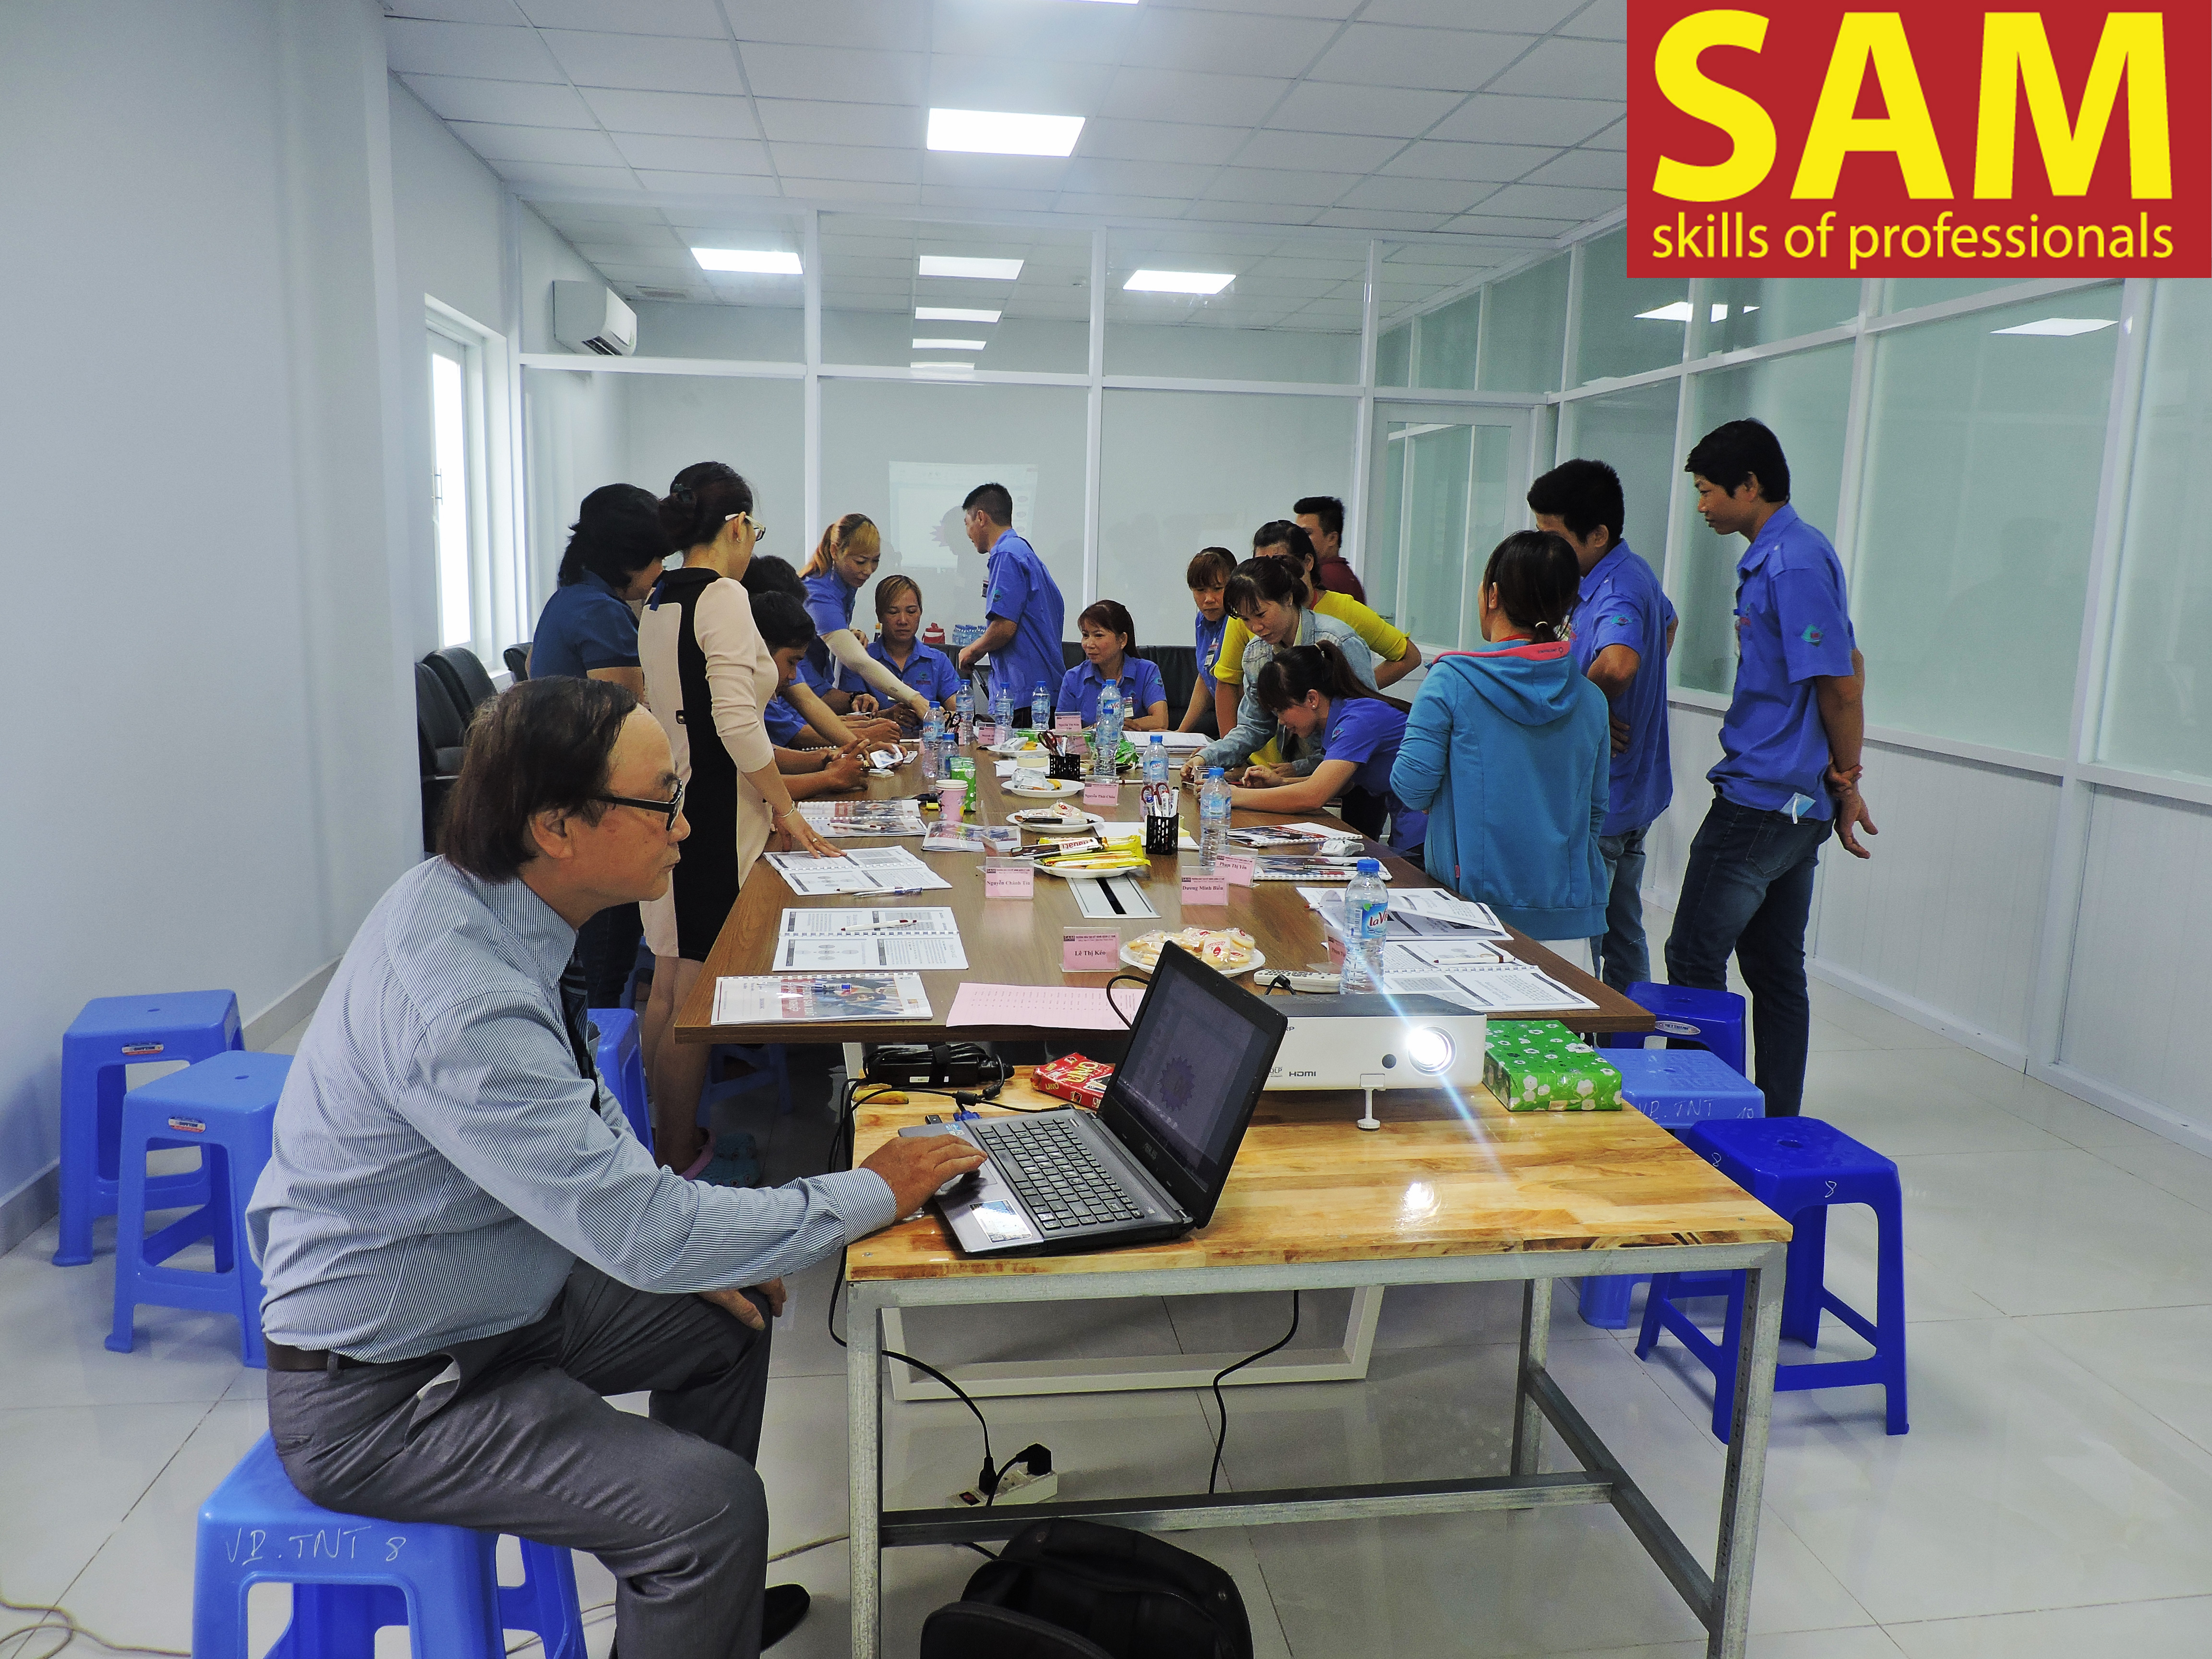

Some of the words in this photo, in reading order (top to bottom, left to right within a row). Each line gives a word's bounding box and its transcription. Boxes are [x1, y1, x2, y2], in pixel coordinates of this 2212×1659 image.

[1711, 1152, 1721, 1167] 8
[1825, 1180, 1837, 1198] 8
[385, 1537, 407, 1562] 8
